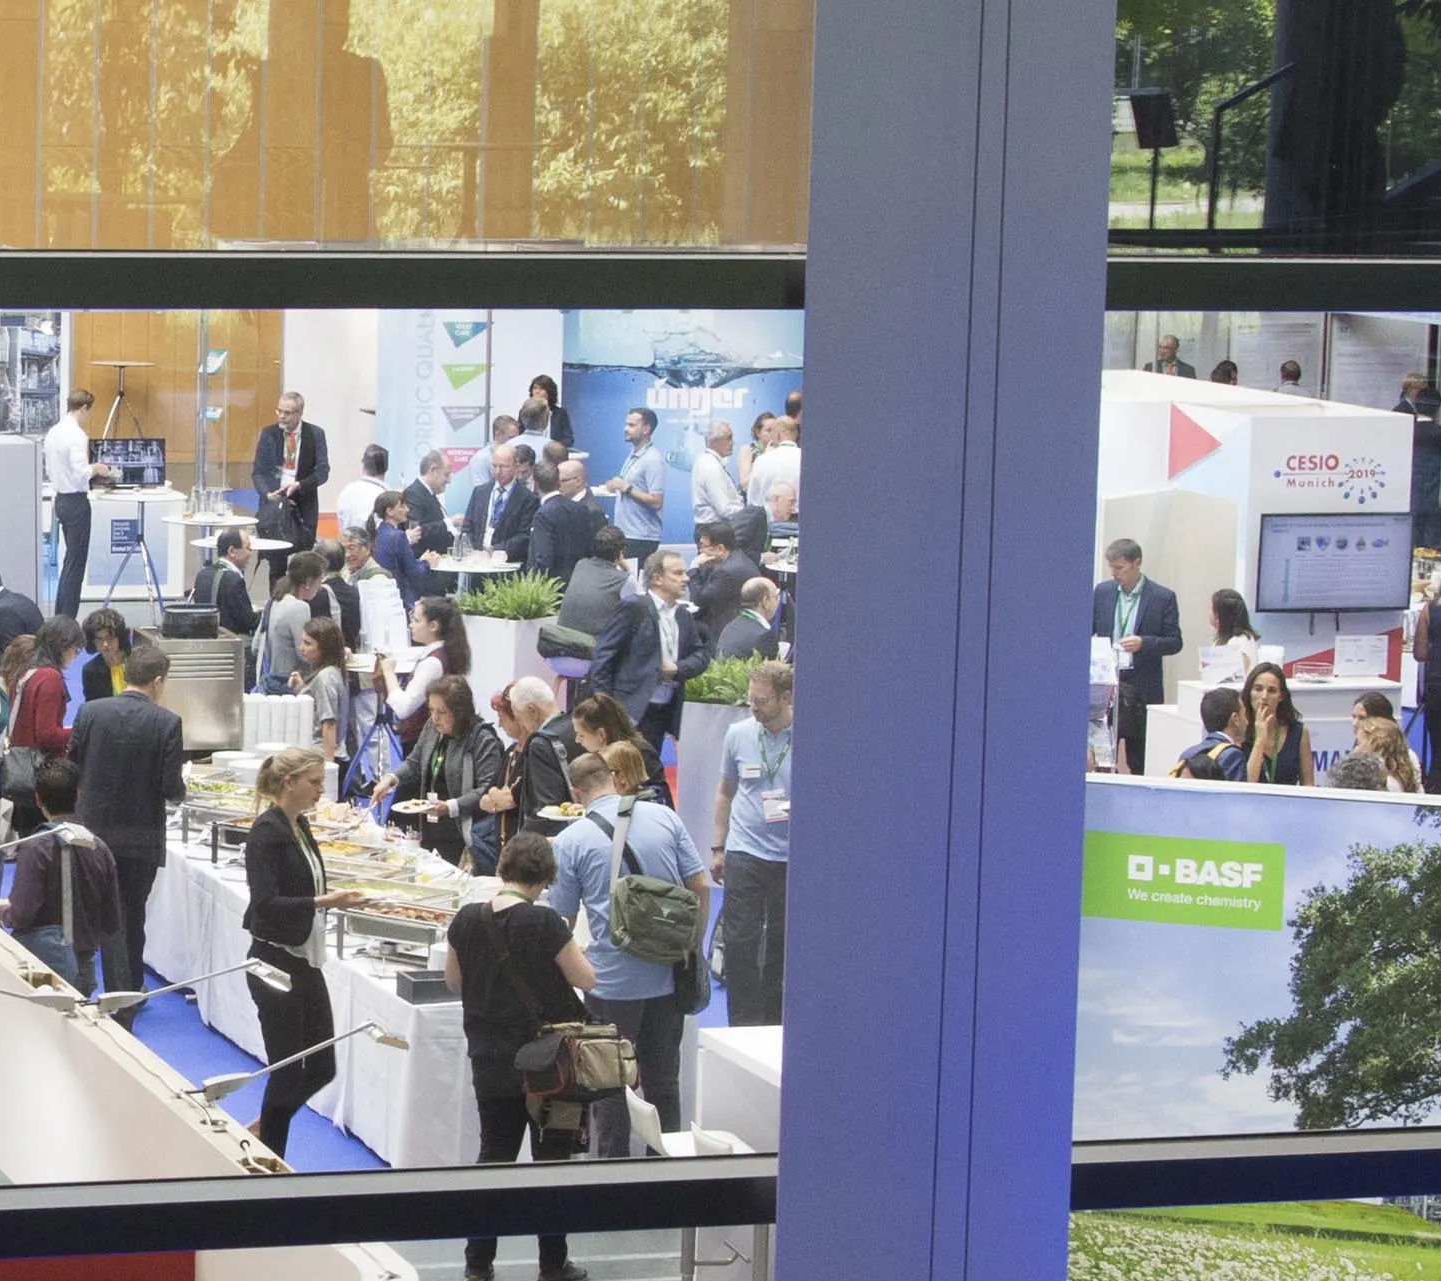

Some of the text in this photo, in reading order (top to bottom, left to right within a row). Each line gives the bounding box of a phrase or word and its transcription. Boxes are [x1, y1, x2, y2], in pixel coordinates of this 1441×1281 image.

[1286, 454, 1339, 471] CESIO
[1287, 478, 1334, 488] Munich
[1349, 470, 1376, 479] 2019
[1175, 858, 1263, 888] BASF
[1128, 888, 1262, 912] We create chemistry
